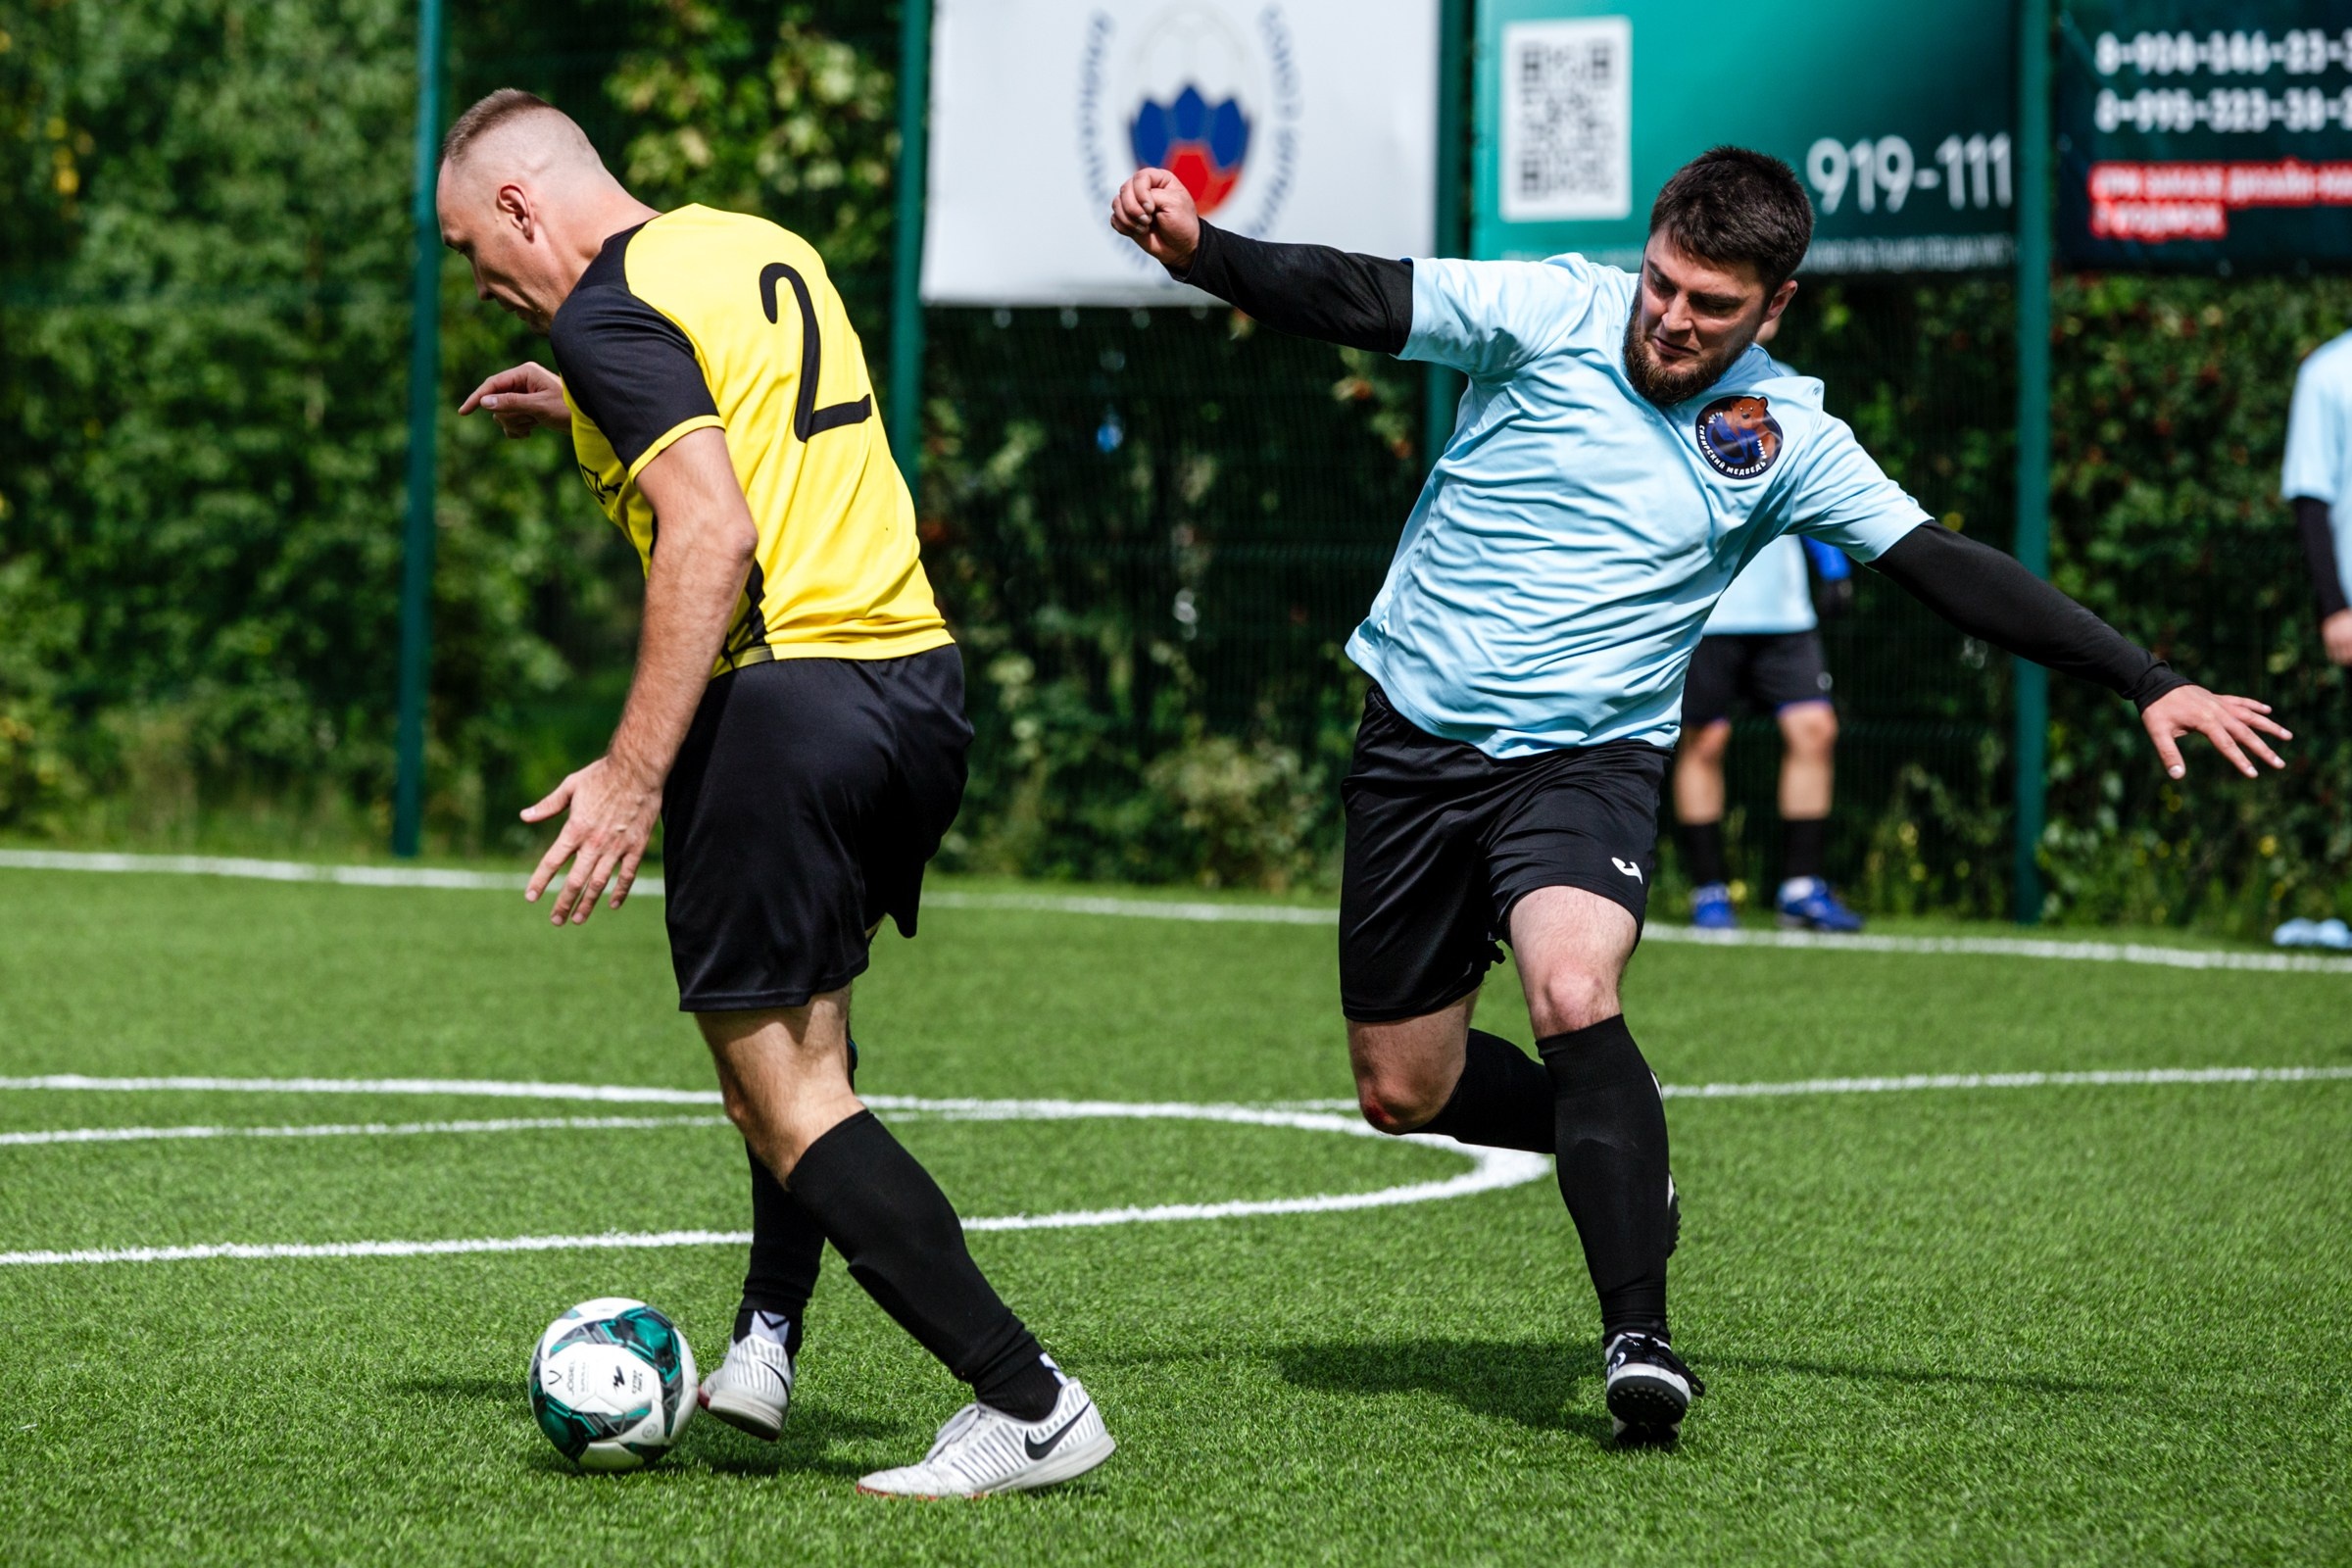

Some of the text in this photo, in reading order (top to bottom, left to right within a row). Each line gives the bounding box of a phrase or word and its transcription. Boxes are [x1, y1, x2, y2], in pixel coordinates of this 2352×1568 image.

[1807, 132, 2012, 214] 919-111
[760, 263, 872, 443] 2
[1698, 425, 1767, 476] СИБИРСКИЙ МЕДВЕДЬ
